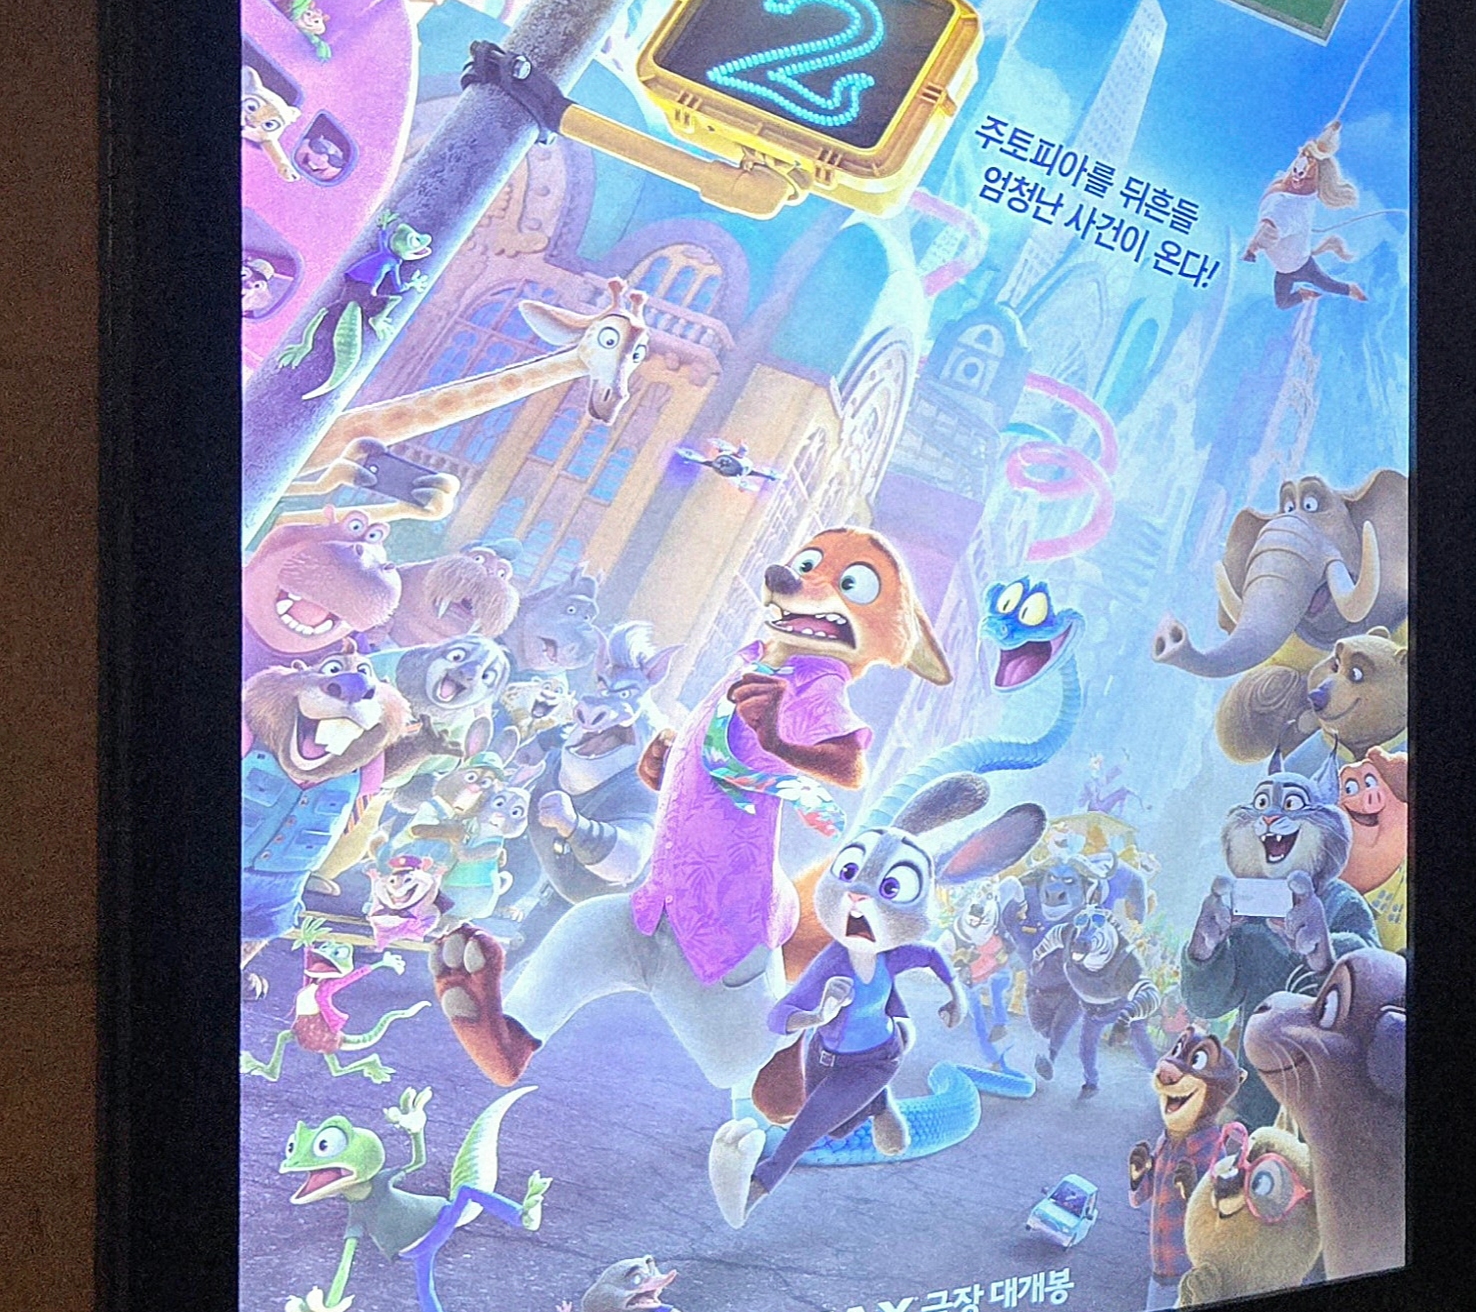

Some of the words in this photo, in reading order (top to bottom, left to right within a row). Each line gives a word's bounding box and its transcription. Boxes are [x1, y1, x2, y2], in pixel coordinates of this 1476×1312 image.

[975, 115, 1116, 198] 주토피아를
[1120, 176, 1199, 234] 뒤흔들
[979, 166, 1064, 225] 엄청난
[1064, 203, 1149, 262] 사건이
[1153, 240, 1220, 288] 온다!
[989, 1267, 1075, 1309] 대개봉
